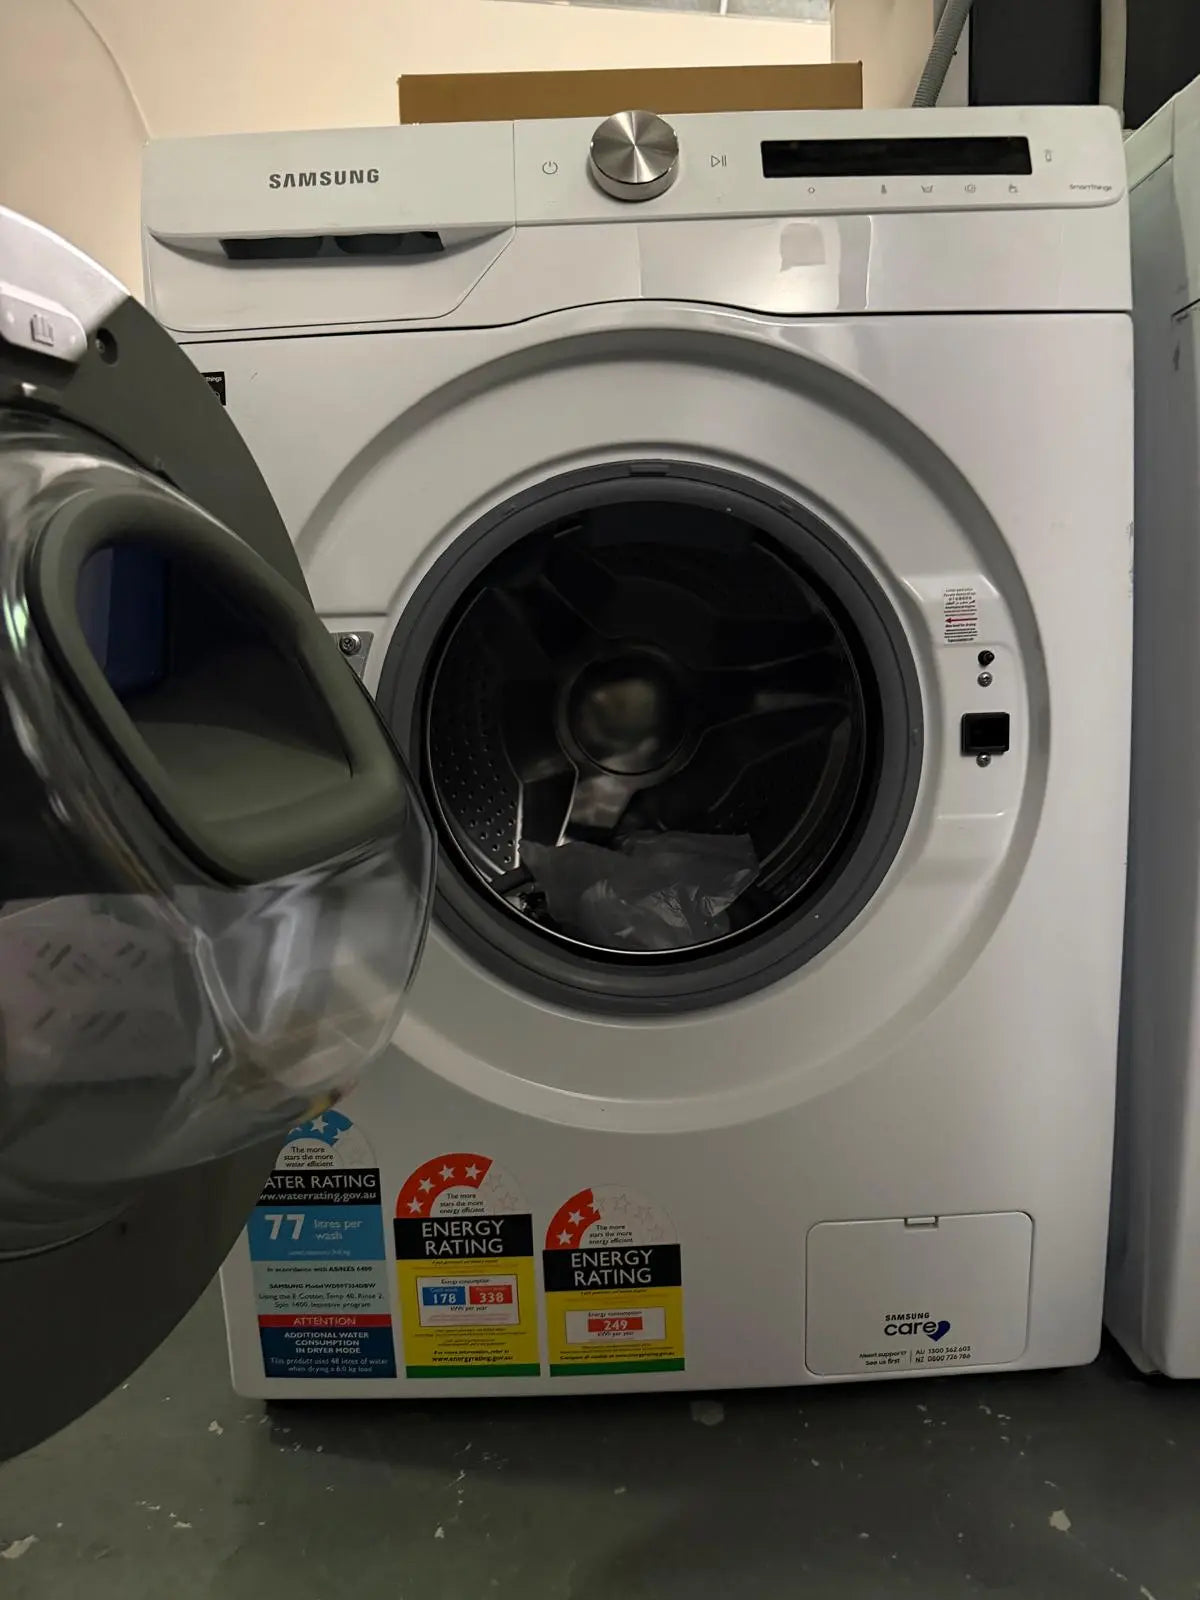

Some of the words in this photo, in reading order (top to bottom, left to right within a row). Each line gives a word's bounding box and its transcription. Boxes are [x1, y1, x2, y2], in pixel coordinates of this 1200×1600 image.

[269, 168, 379, 189] SAMSUNG
[264, 1175, 306, 1189] ATER
[311, 1174, 376, 1188] RATING
[265, 1214, 306, 1241] 77
[314, 1219, 341, 1229] litres
[344, 1220, 362, 1230] per
[422, 1220, 504, 1238] ENERGY
[315, 1231, 343, 1240] wash
[425, 1238, 503, 1256] RATING
[571, 1249, 653, 1268] ENERGY
[574, 1268, 652, 1286] RATING
[433, 1293, 457, 1304] 178
[479, 1292, 505, 1304] 338
[293, 1317, 357, 1325] ATTENTION
[885, 1312, 930, 1321] SAMSUNG
[603, 1319, 629, 1331] 249
[884, 1321, 937, 1336] care
[287, 1358, 312, 1366] product
